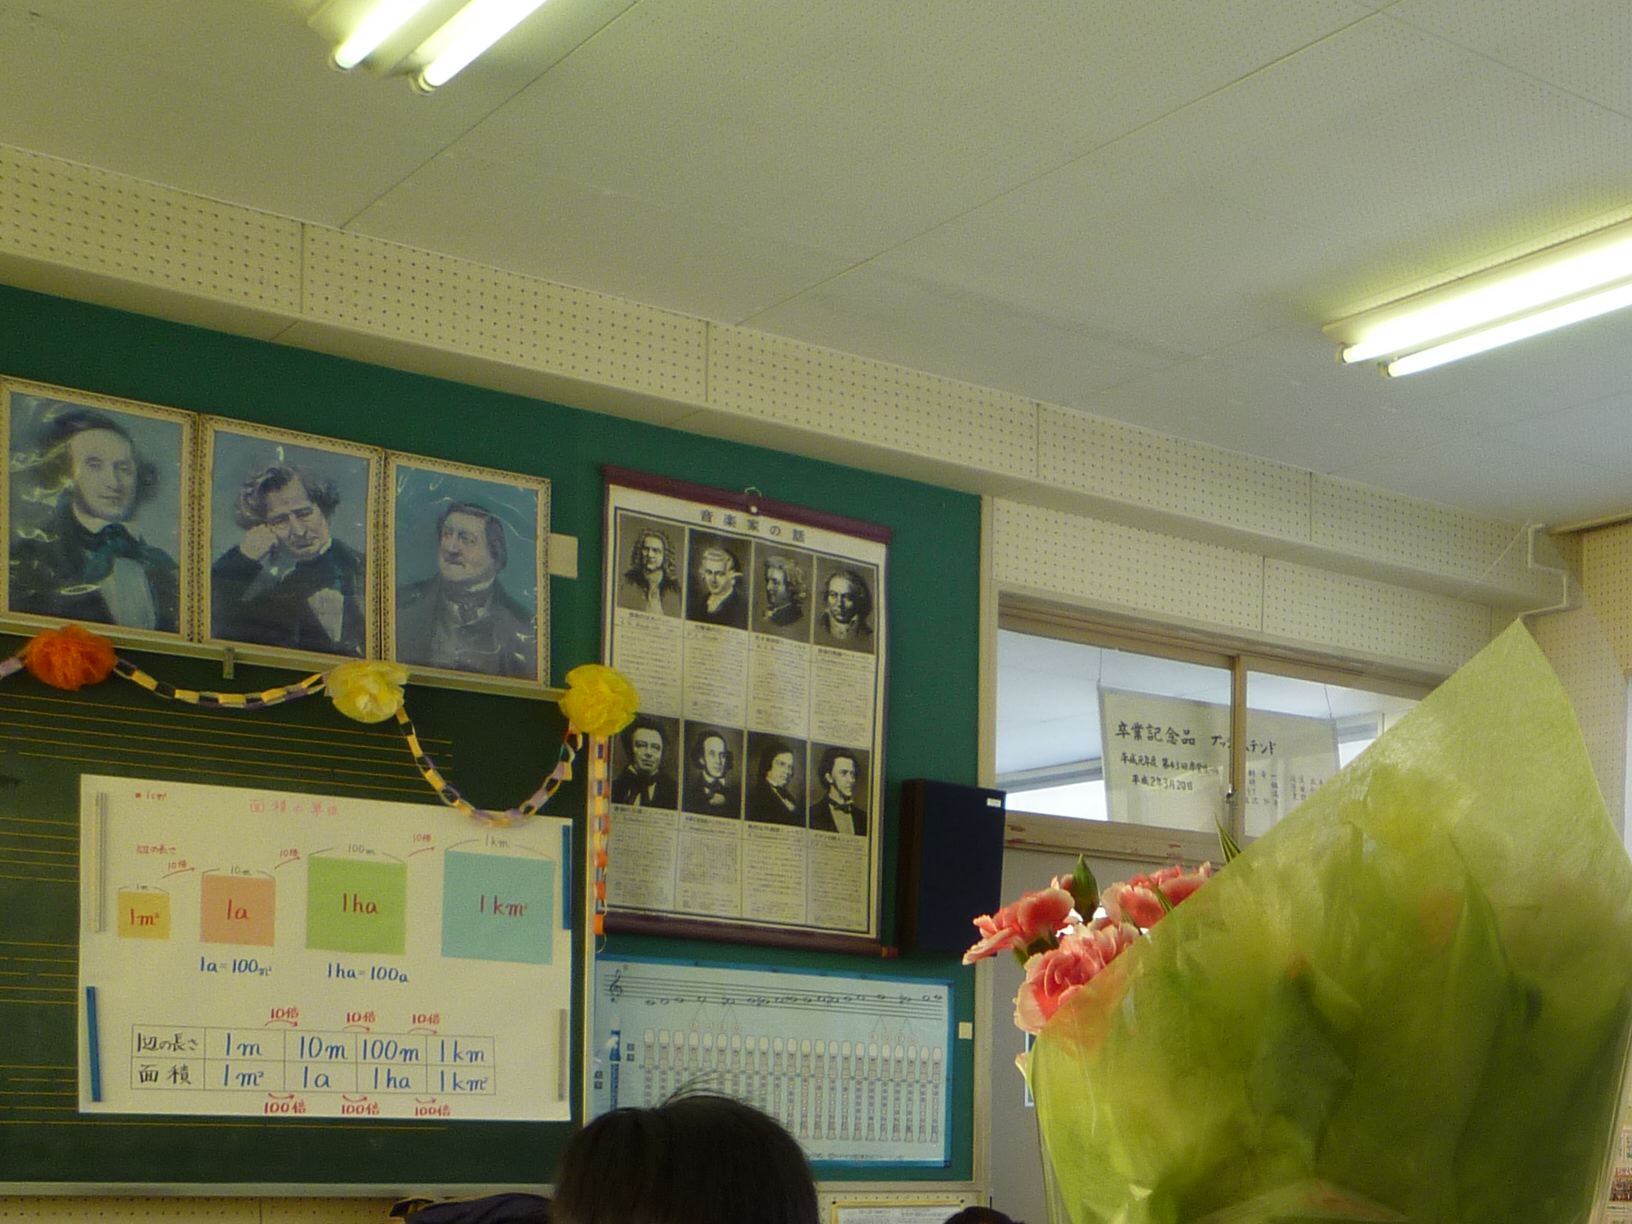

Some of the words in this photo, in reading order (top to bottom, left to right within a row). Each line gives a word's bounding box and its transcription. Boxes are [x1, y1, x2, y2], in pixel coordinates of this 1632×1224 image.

[1115, 721, 1196, 746] 卒業記念品
[227, 899, 249, 920] 1a
[342, 893, 378, 914] 1ha
[271, 1007, 299, 1019] 10倍
[299, 1035, 348, 1060] 10m
[363, 1039, 419, 1062] 100m
[303, 1066, 332, 1089] 1a
[373, 1067, 411, 1089] 1ha
[264, 1101, 306, 1114] 100倍
[341, 1102, 380, 1115] 100倍
